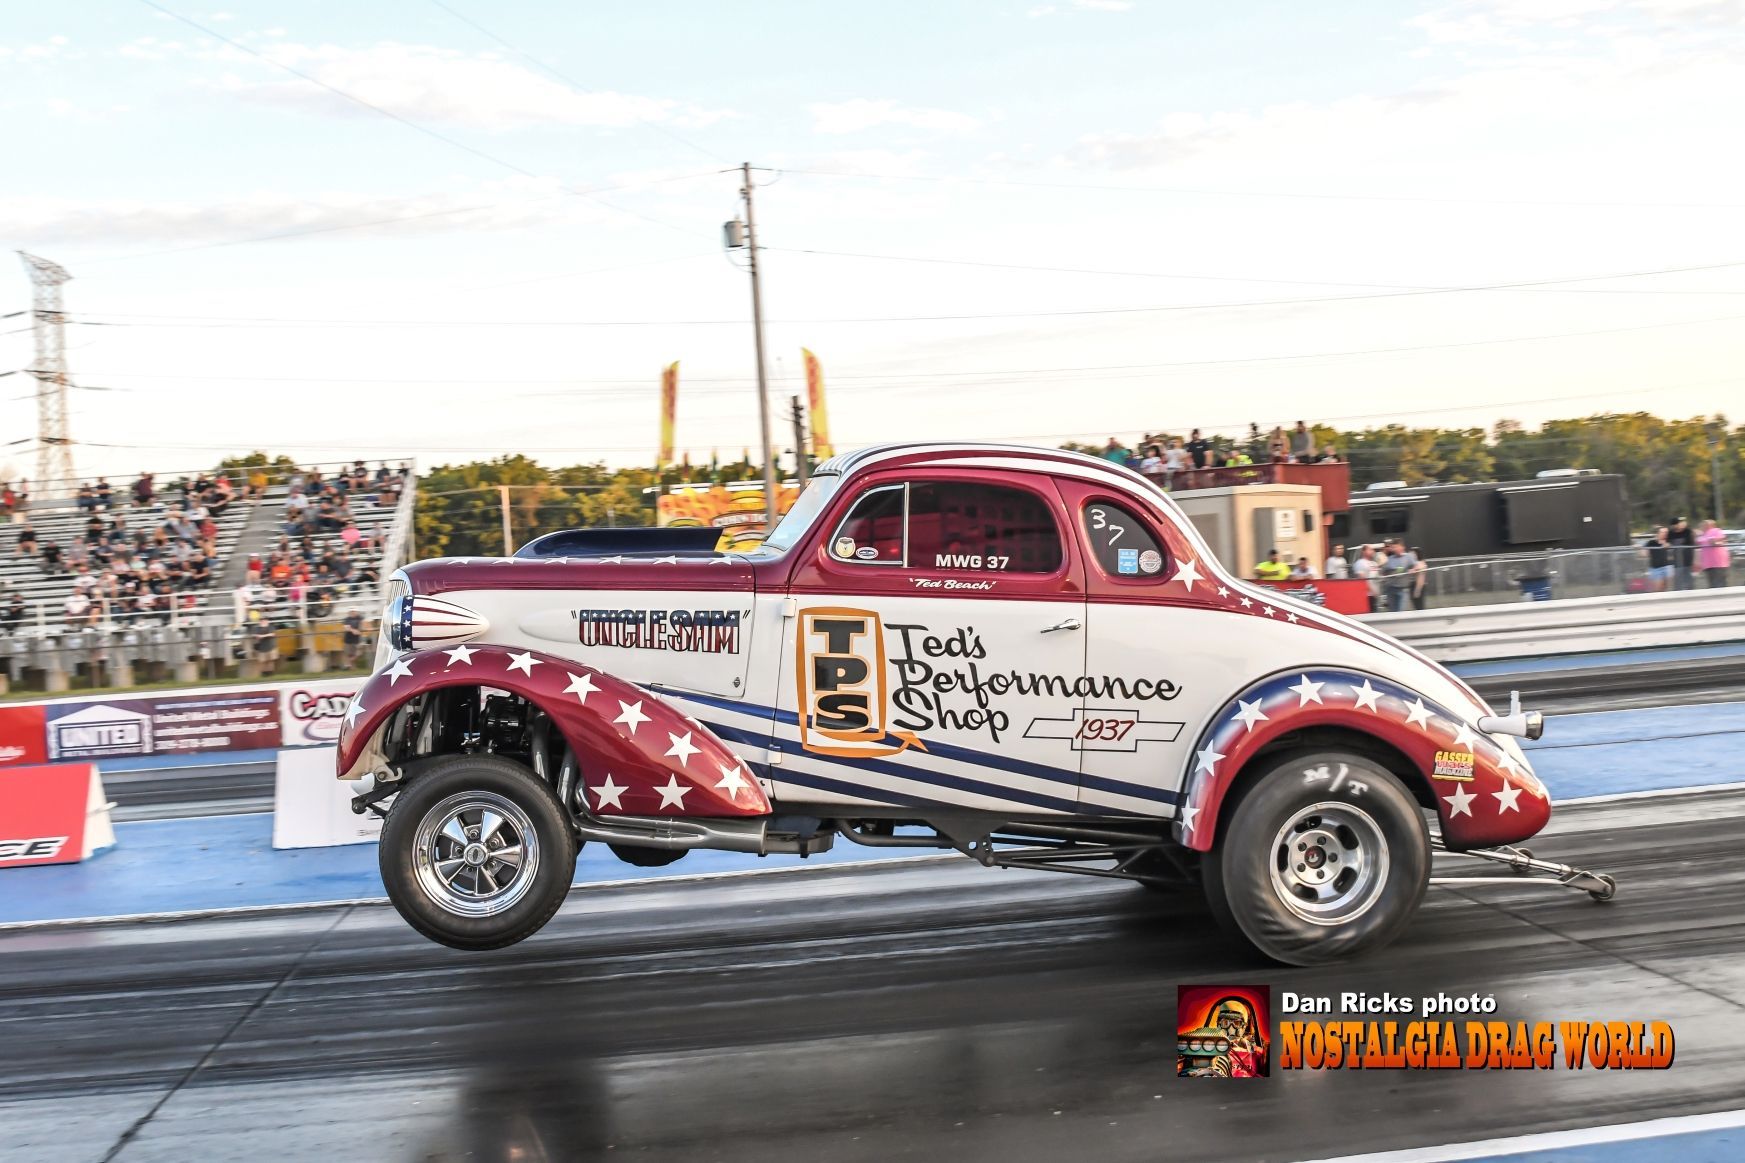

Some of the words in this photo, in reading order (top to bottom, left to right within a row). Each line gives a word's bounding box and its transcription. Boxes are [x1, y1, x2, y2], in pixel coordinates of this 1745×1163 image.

[935, 554, 982, 569] MWG
[987, 555, 1009, 569] 37
[884, 622, 987, 662] Ted's
[811, 615, 871, 733] TPS
[888, 658, 1182, 708] Performance
[291, 690, 352, 719] CAD
[892, 686, 1009, 744] Shop
[1075, 717, 1136, 743] 1937
[1303, 763, 1369, 796] M/T
